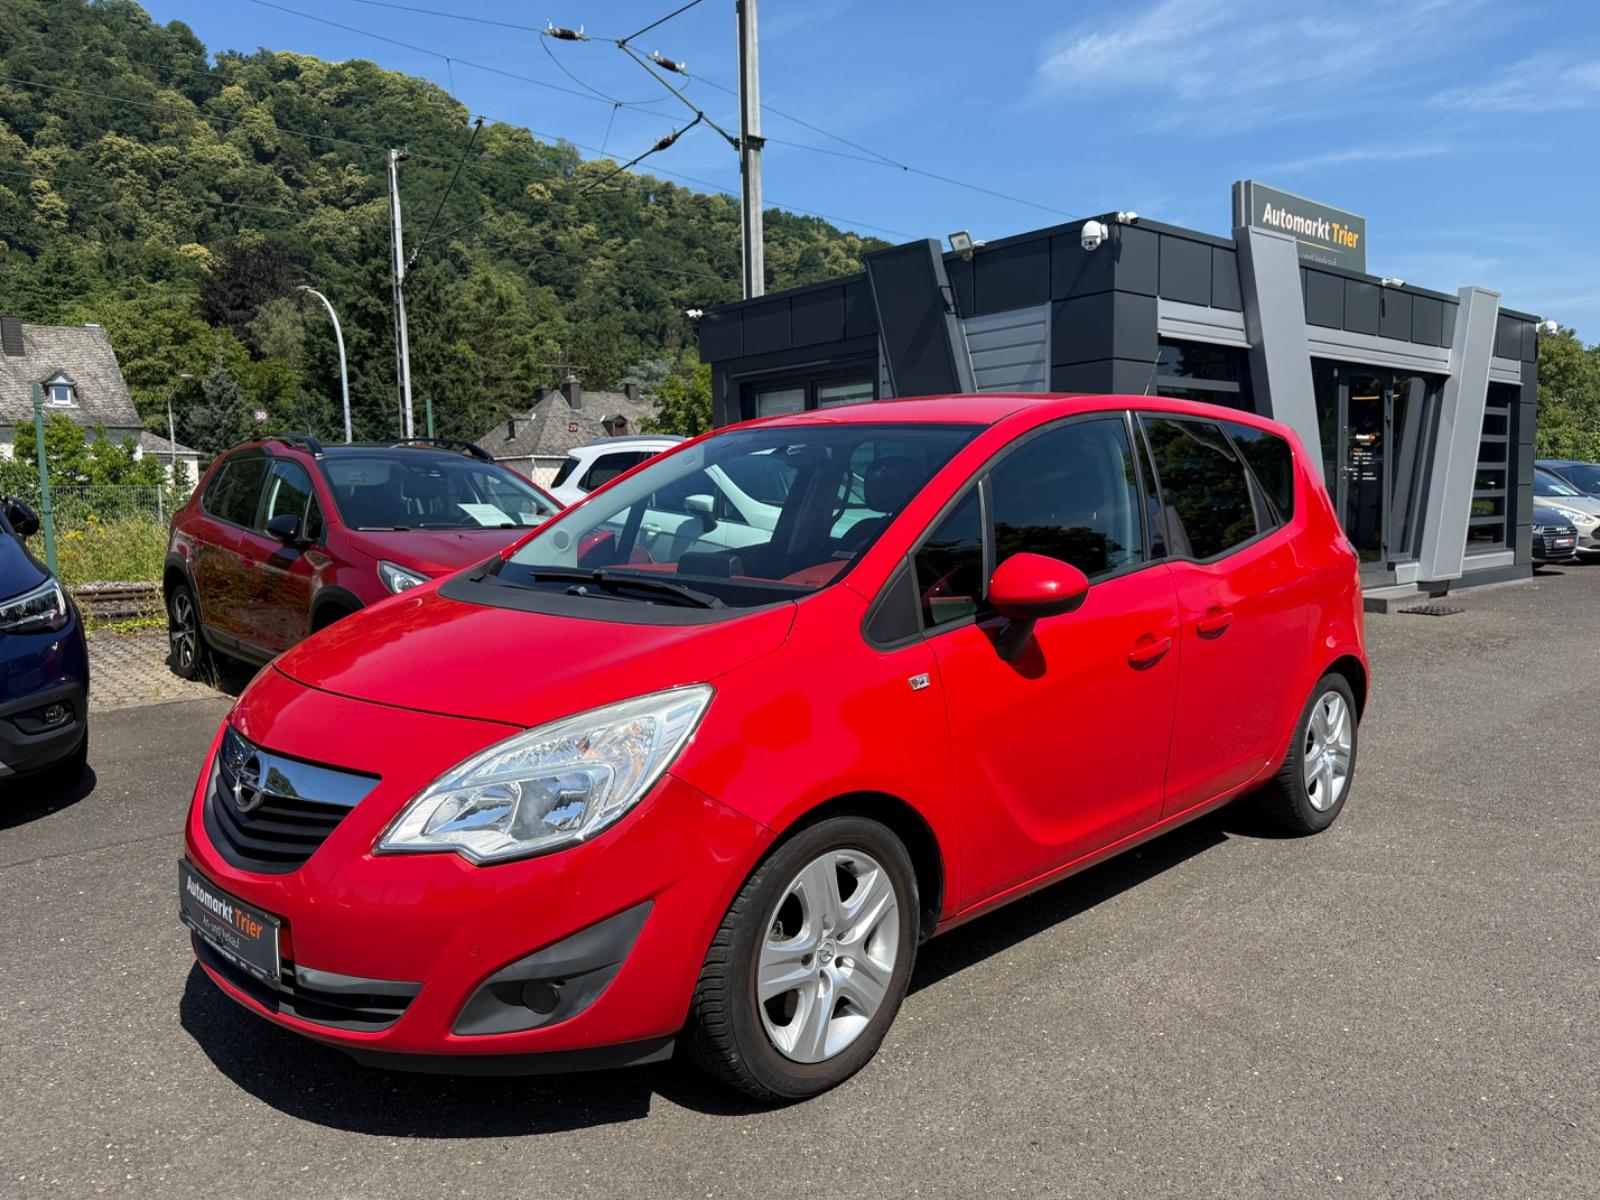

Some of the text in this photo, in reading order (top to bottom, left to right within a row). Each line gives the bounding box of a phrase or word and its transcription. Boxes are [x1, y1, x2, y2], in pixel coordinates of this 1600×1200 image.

[1263, 203, 1359, 248] Automarkt Trier
[186, 876, 233, 923] Automarkt
[235, 909, 263, 939] Trier
